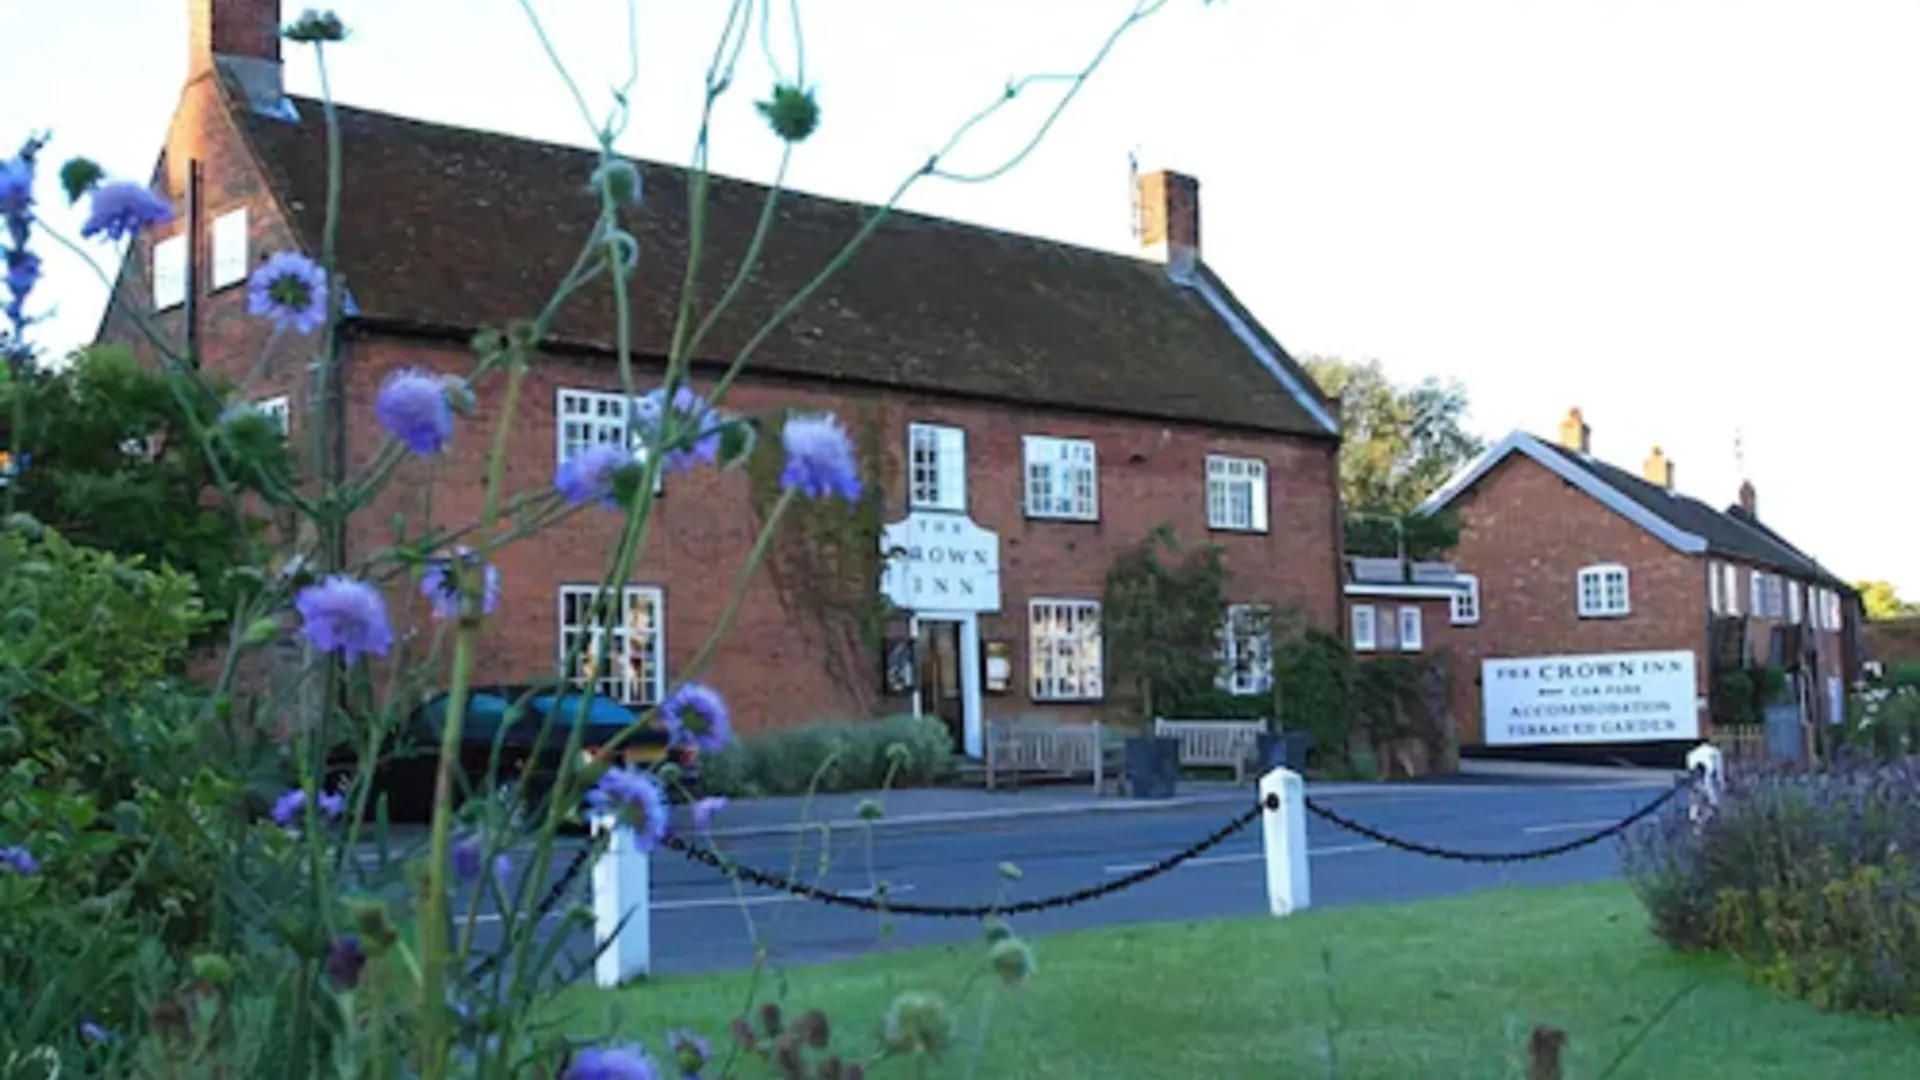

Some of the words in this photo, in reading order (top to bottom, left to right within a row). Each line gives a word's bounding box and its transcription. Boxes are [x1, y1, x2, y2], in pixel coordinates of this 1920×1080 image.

[918, 519, 961, 535] THE
[888, 545, 988, 565] ROWN
[913, 577, 976, 595] INN
[1538, 660, 1635, 681] CROWN
[1642, 660, 1682, 674] INN
[1570, 685, 1600, 697] CAR
[1605, 684, 1642, 695] PARK
[1510, 700, 1672, 717] ACCOMMODATION
[1507, 722, 1597, 736] TERRACED
[1601, 719, 1676, 735] GARDEN
